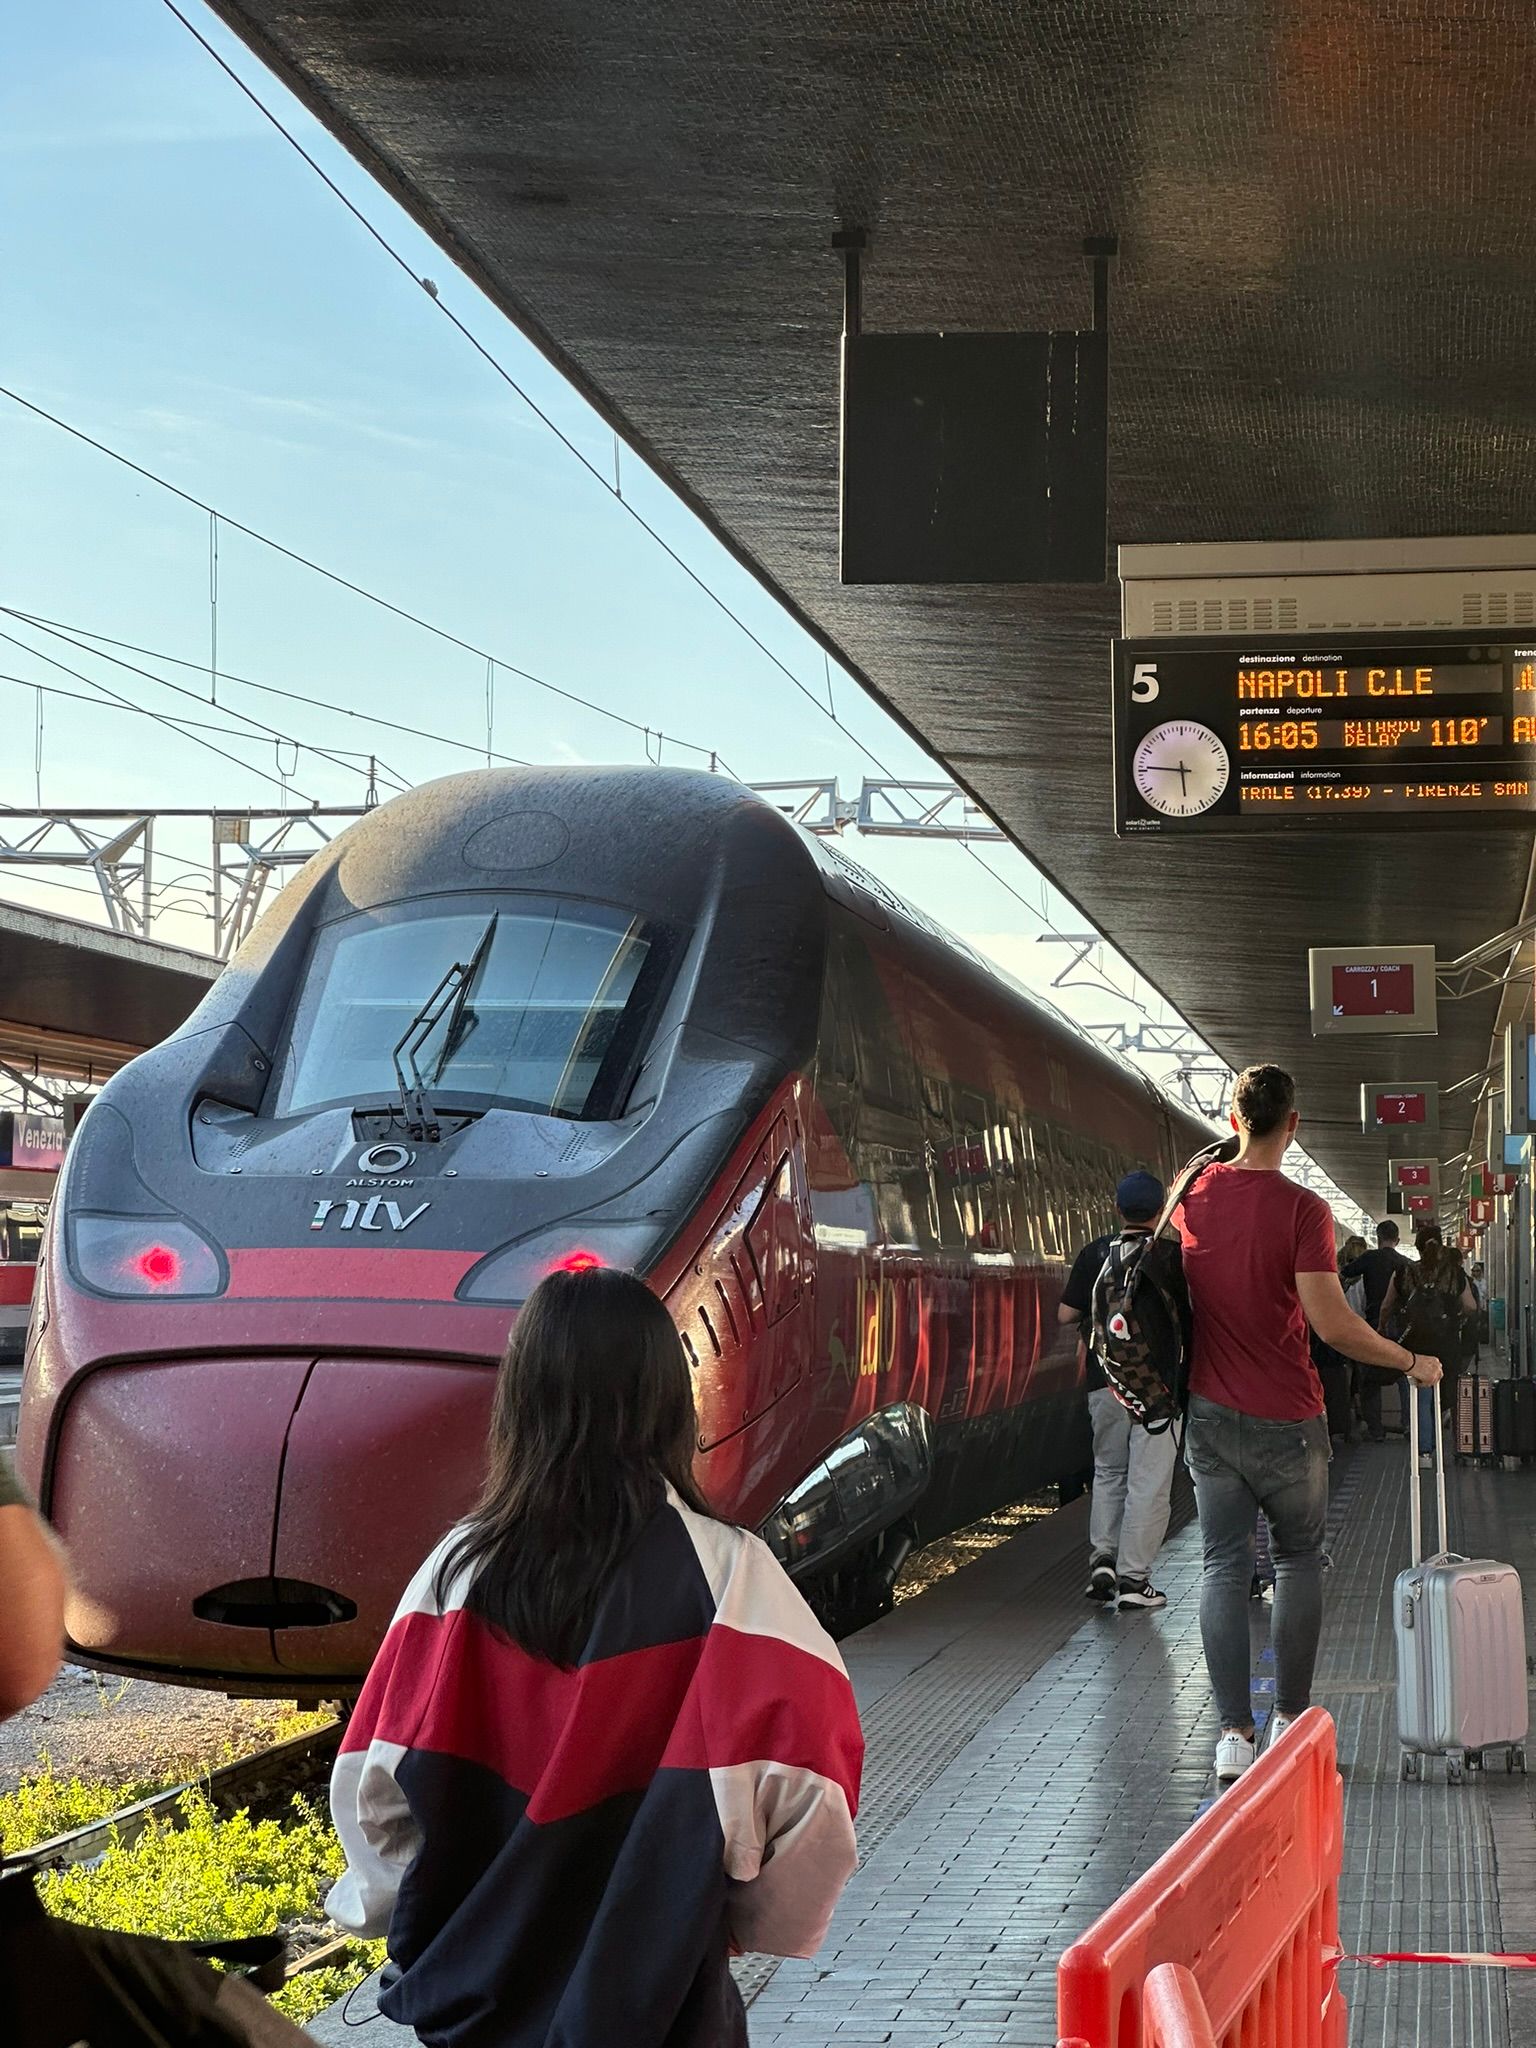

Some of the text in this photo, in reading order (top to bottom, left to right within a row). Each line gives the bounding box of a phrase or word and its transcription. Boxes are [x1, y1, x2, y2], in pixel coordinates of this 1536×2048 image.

[1239, 654, 1343, 663] destinazione destination
[1131, 664, 1160, 703] 5
[1238, 668, 1433, 698] NAPOLI C.LE
[1240, 706, 1322, 716] partenza departure
[1239, 721, 1318, 750] 16:05
[1344, 733, 1401, 747] DELAY
[1240, 770, 1341, 779] informazioni information
[1370, 979, 1378, 998] 1
[1398, 1101, 1406, 1114] 2
[1411, 1170, 1418, 1179] 3
[346, 1178, 414, 1186] ALSTOM
[310, 1194, 432, 1231] ntv
